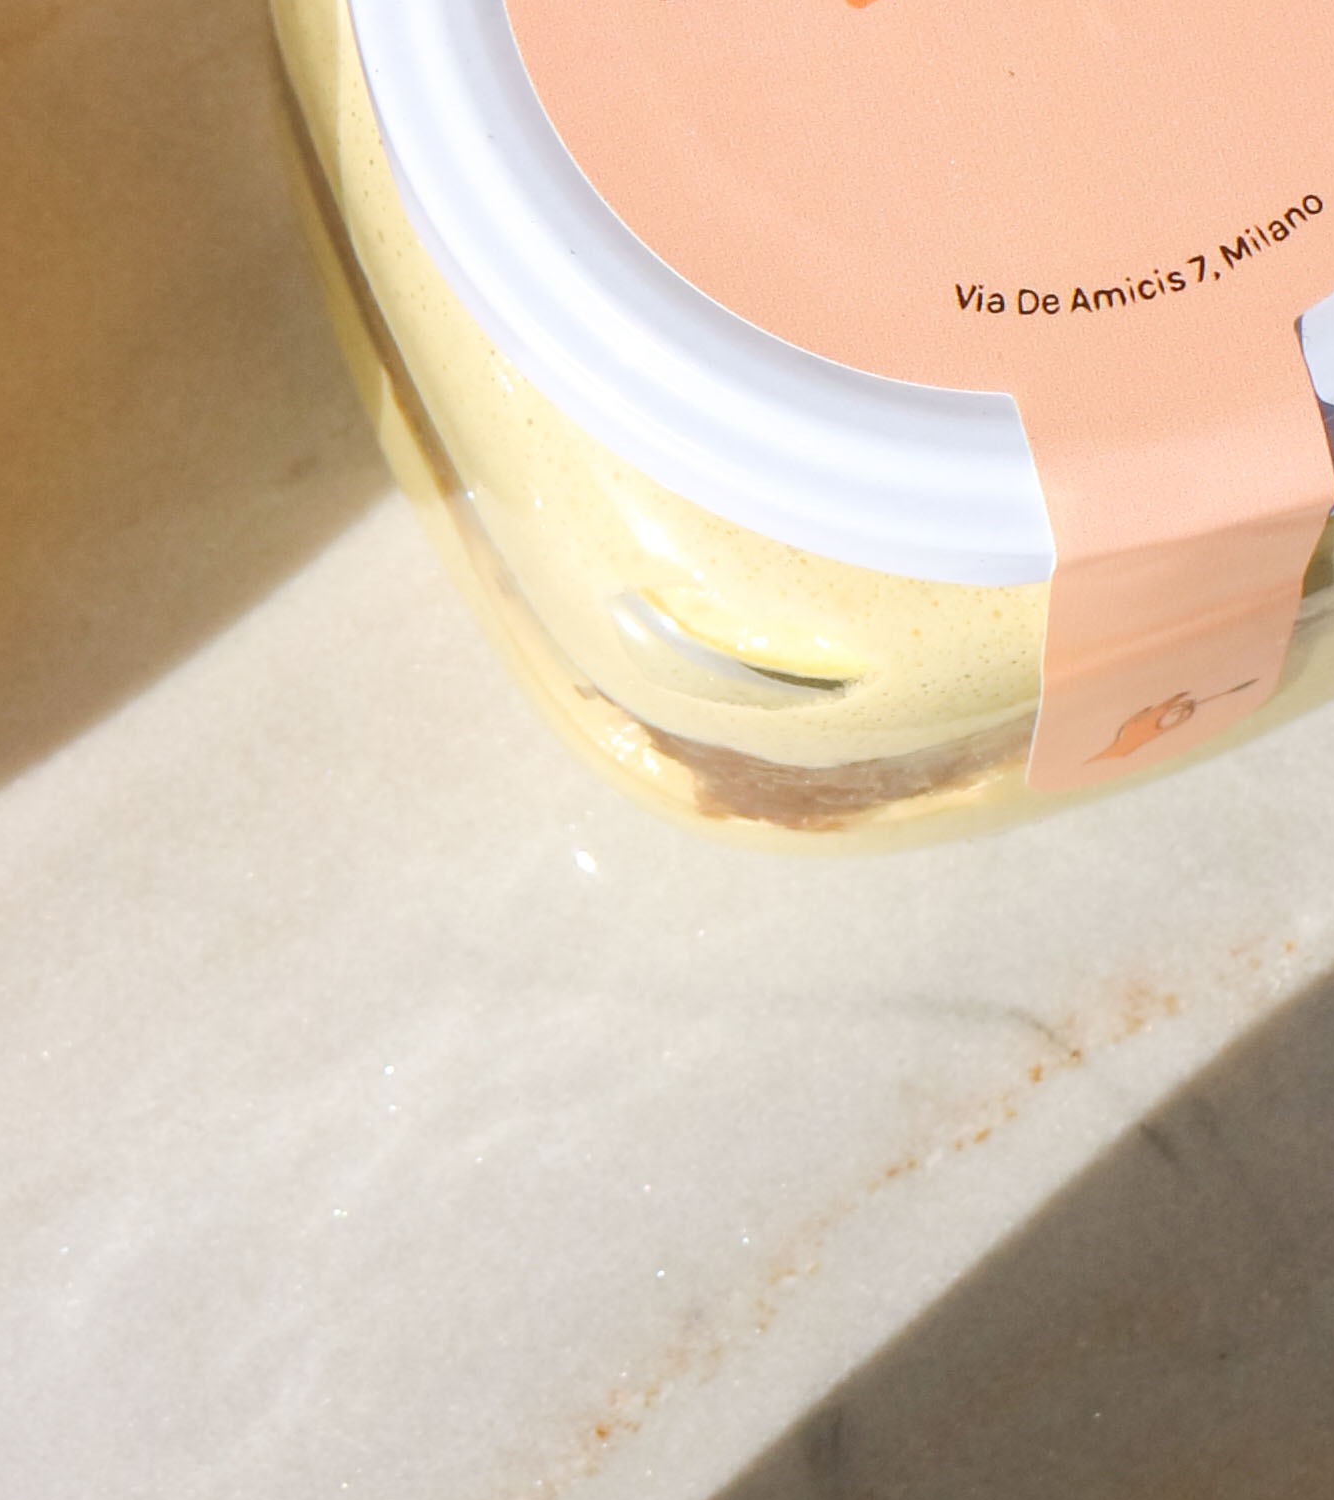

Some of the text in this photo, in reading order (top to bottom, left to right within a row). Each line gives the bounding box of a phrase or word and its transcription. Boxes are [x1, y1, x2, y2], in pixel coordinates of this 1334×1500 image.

[954, 193, 1324, 316] Via De Amicis 7, Milano
